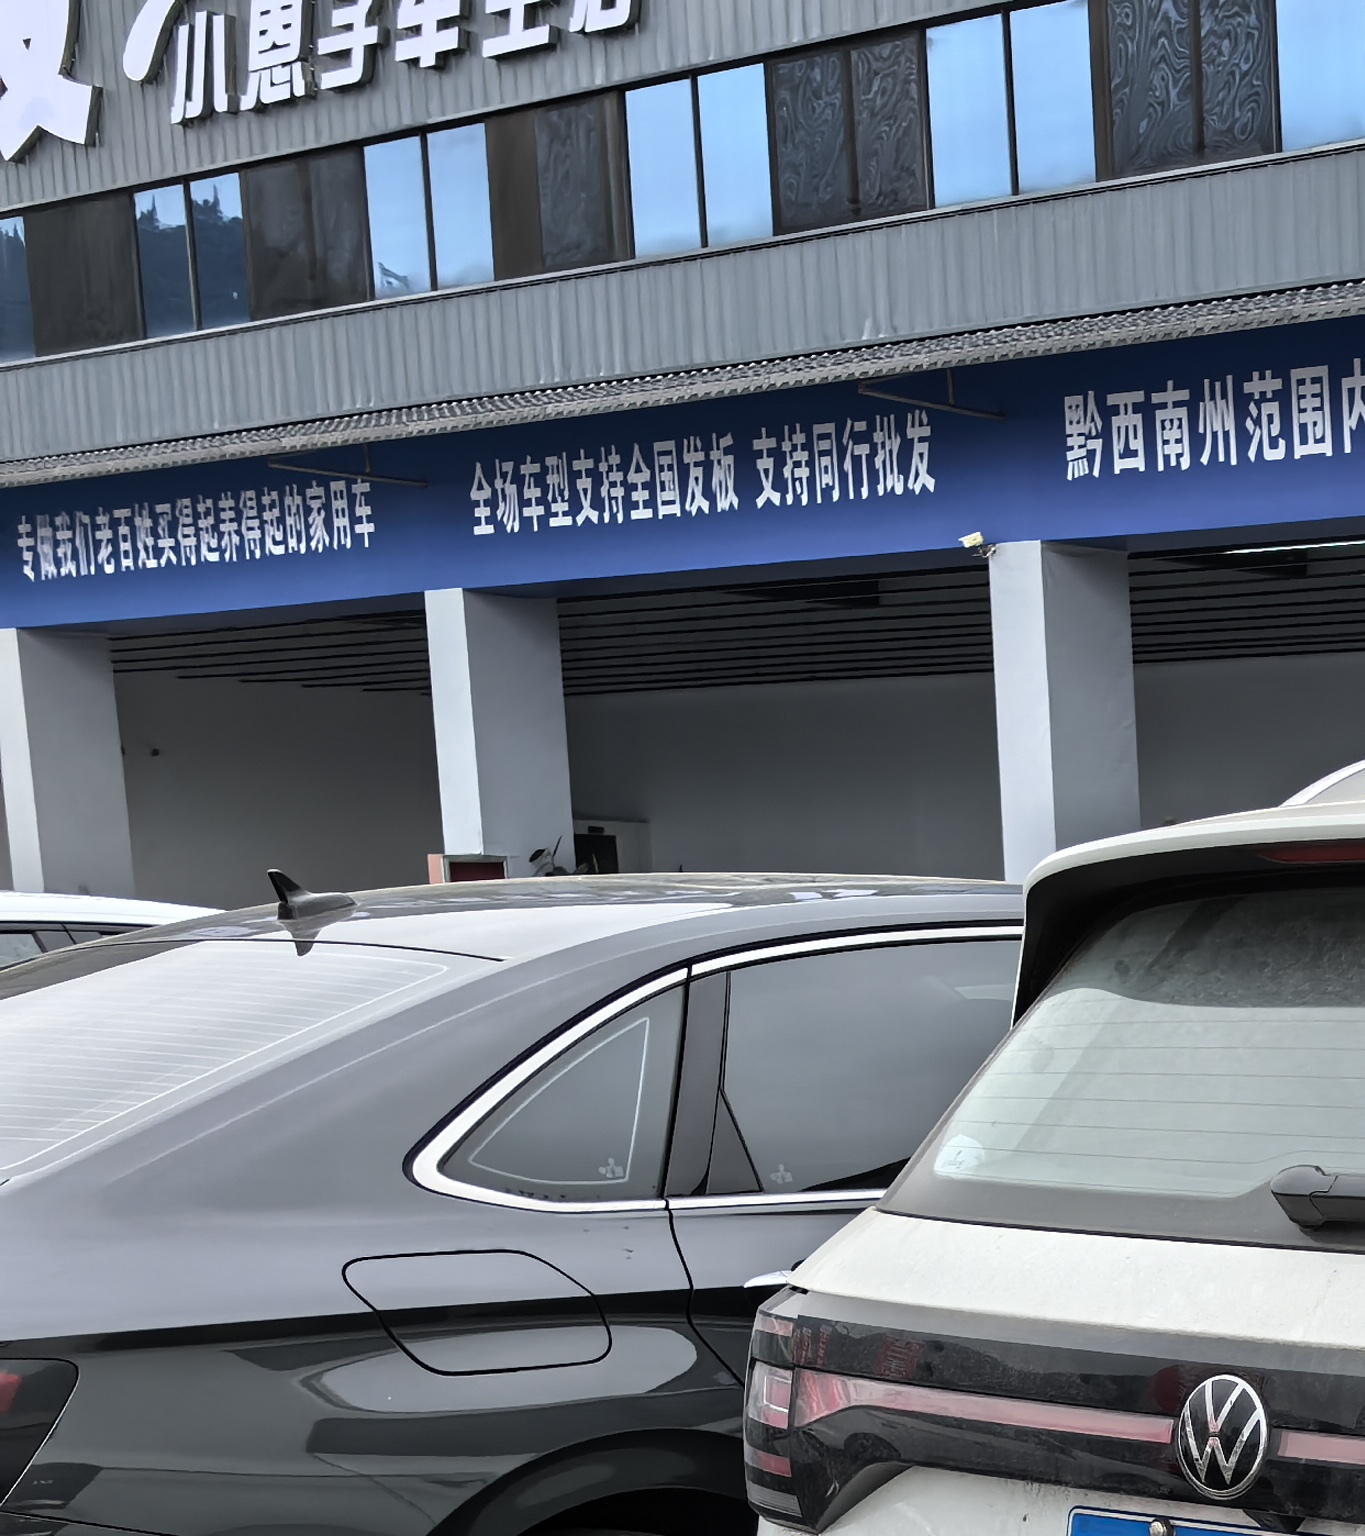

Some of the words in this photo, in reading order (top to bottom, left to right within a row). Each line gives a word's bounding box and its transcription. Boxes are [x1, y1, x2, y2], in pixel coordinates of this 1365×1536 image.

[470, 432, 739, 535] 全场车型支持全国发板
[753, 409, 936, 509] 支持同行批发
[17, 478, 375, 582] 专做我们老百姓买得起养得起的家用车
